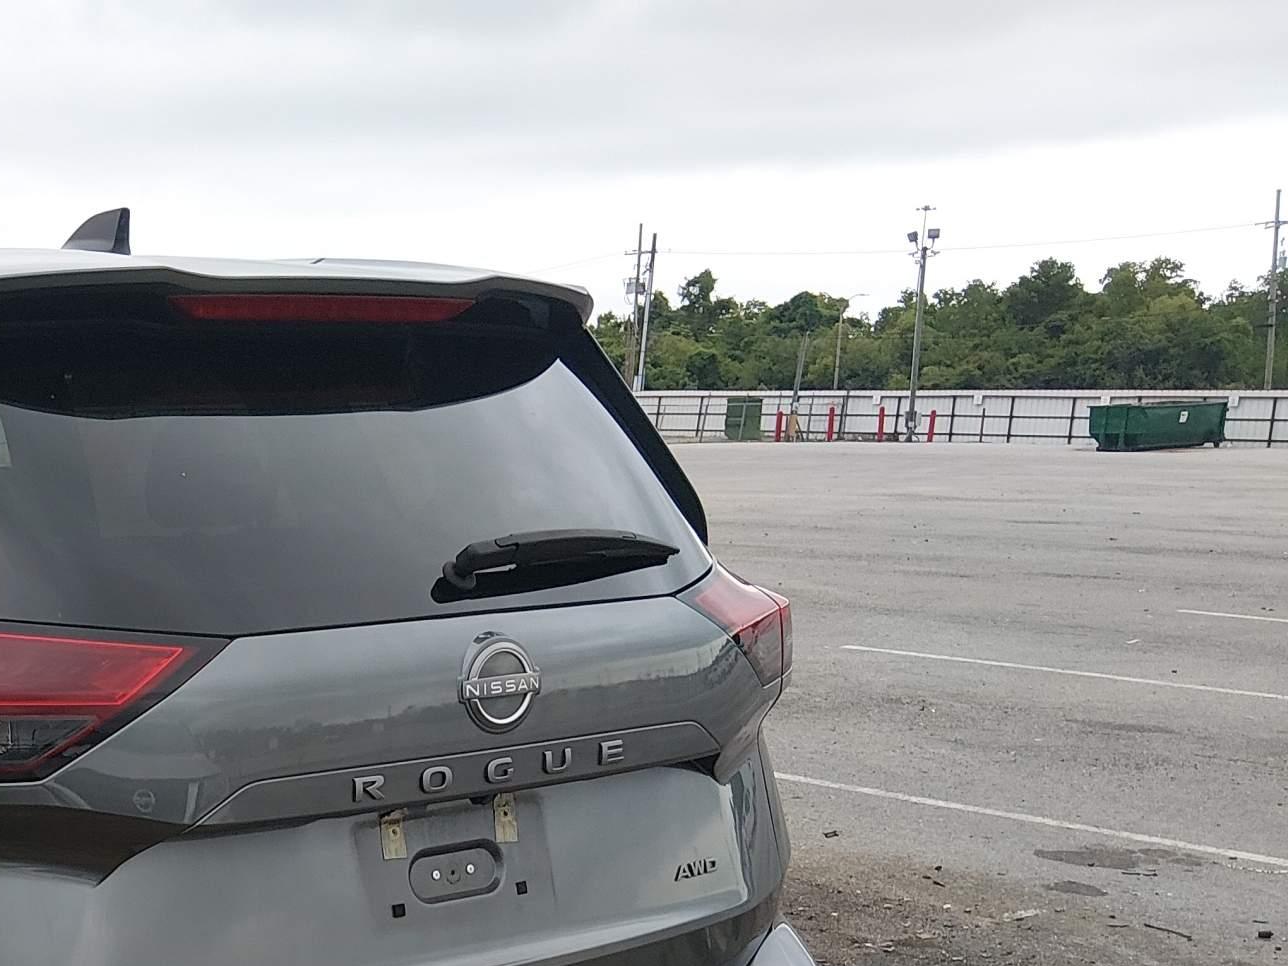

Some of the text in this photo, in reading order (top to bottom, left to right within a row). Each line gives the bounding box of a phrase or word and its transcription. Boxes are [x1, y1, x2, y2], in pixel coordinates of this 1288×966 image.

[465, 676, 540, 697] NISSAN
[352, 739, 625, 803] ROGUE
[674, 858, 718, 882] AWD
